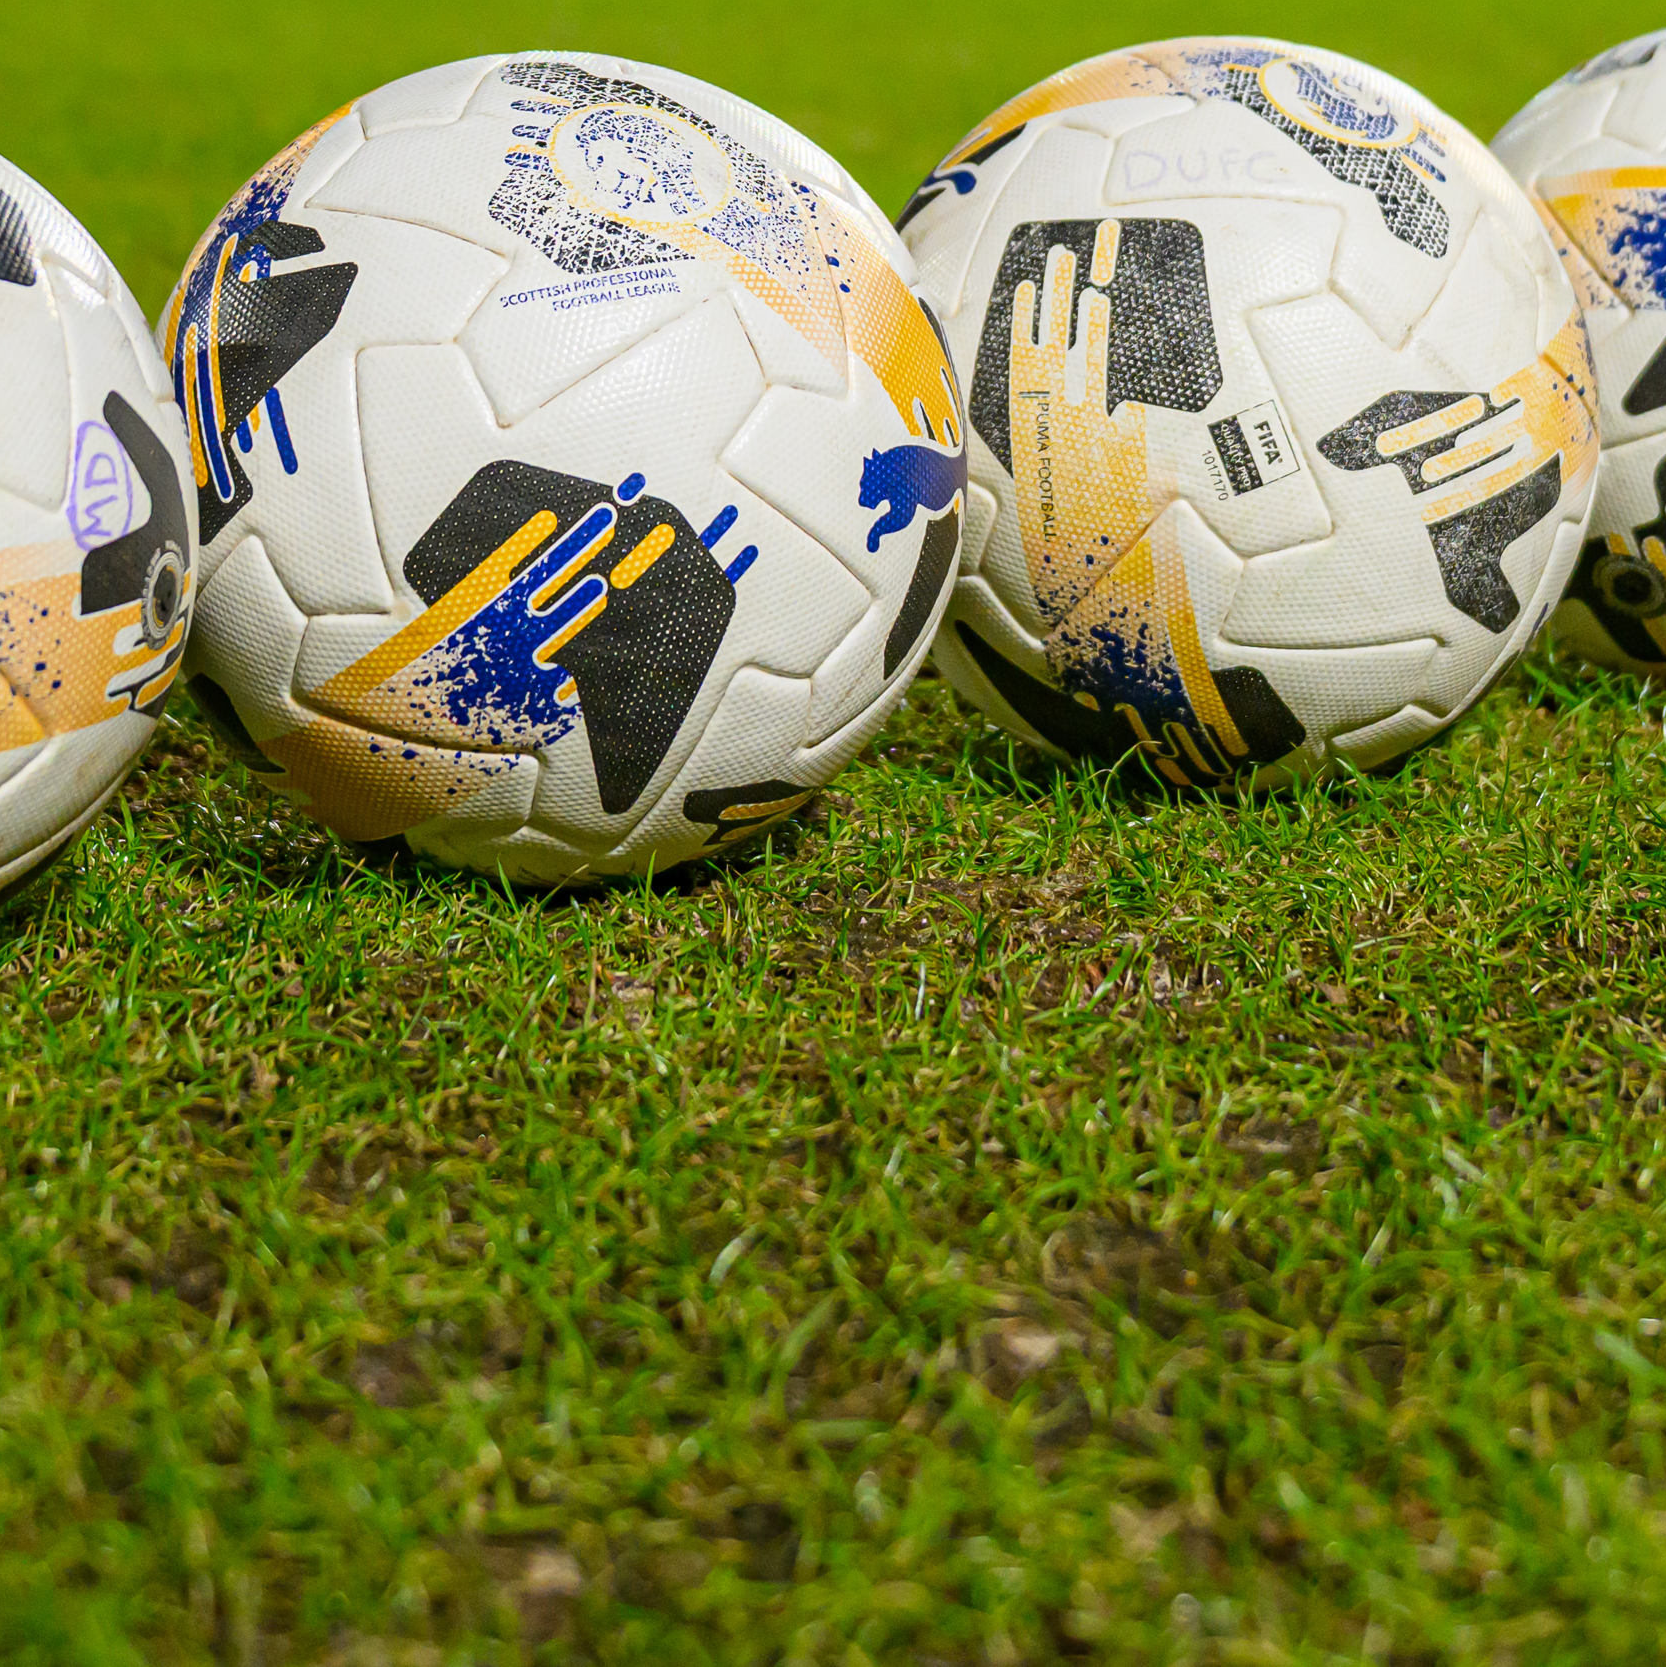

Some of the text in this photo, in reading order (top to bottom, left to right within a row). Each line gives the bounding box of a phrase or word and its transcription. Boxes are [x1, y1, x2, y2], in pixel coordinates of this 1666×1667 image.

[1124, 146, 1296, 192] DUFC
[499, 267, 677, 308] SCOTTISH PROFESSIONAL
[552, 281, 681, 312] FOOTBALL LEAGUE
[1253, 420, 1281, 465] FIFA
[1036, 402, 1057, 543] PUMA FOOTBALL
[1201, 449, 1229, 502] 1017170
